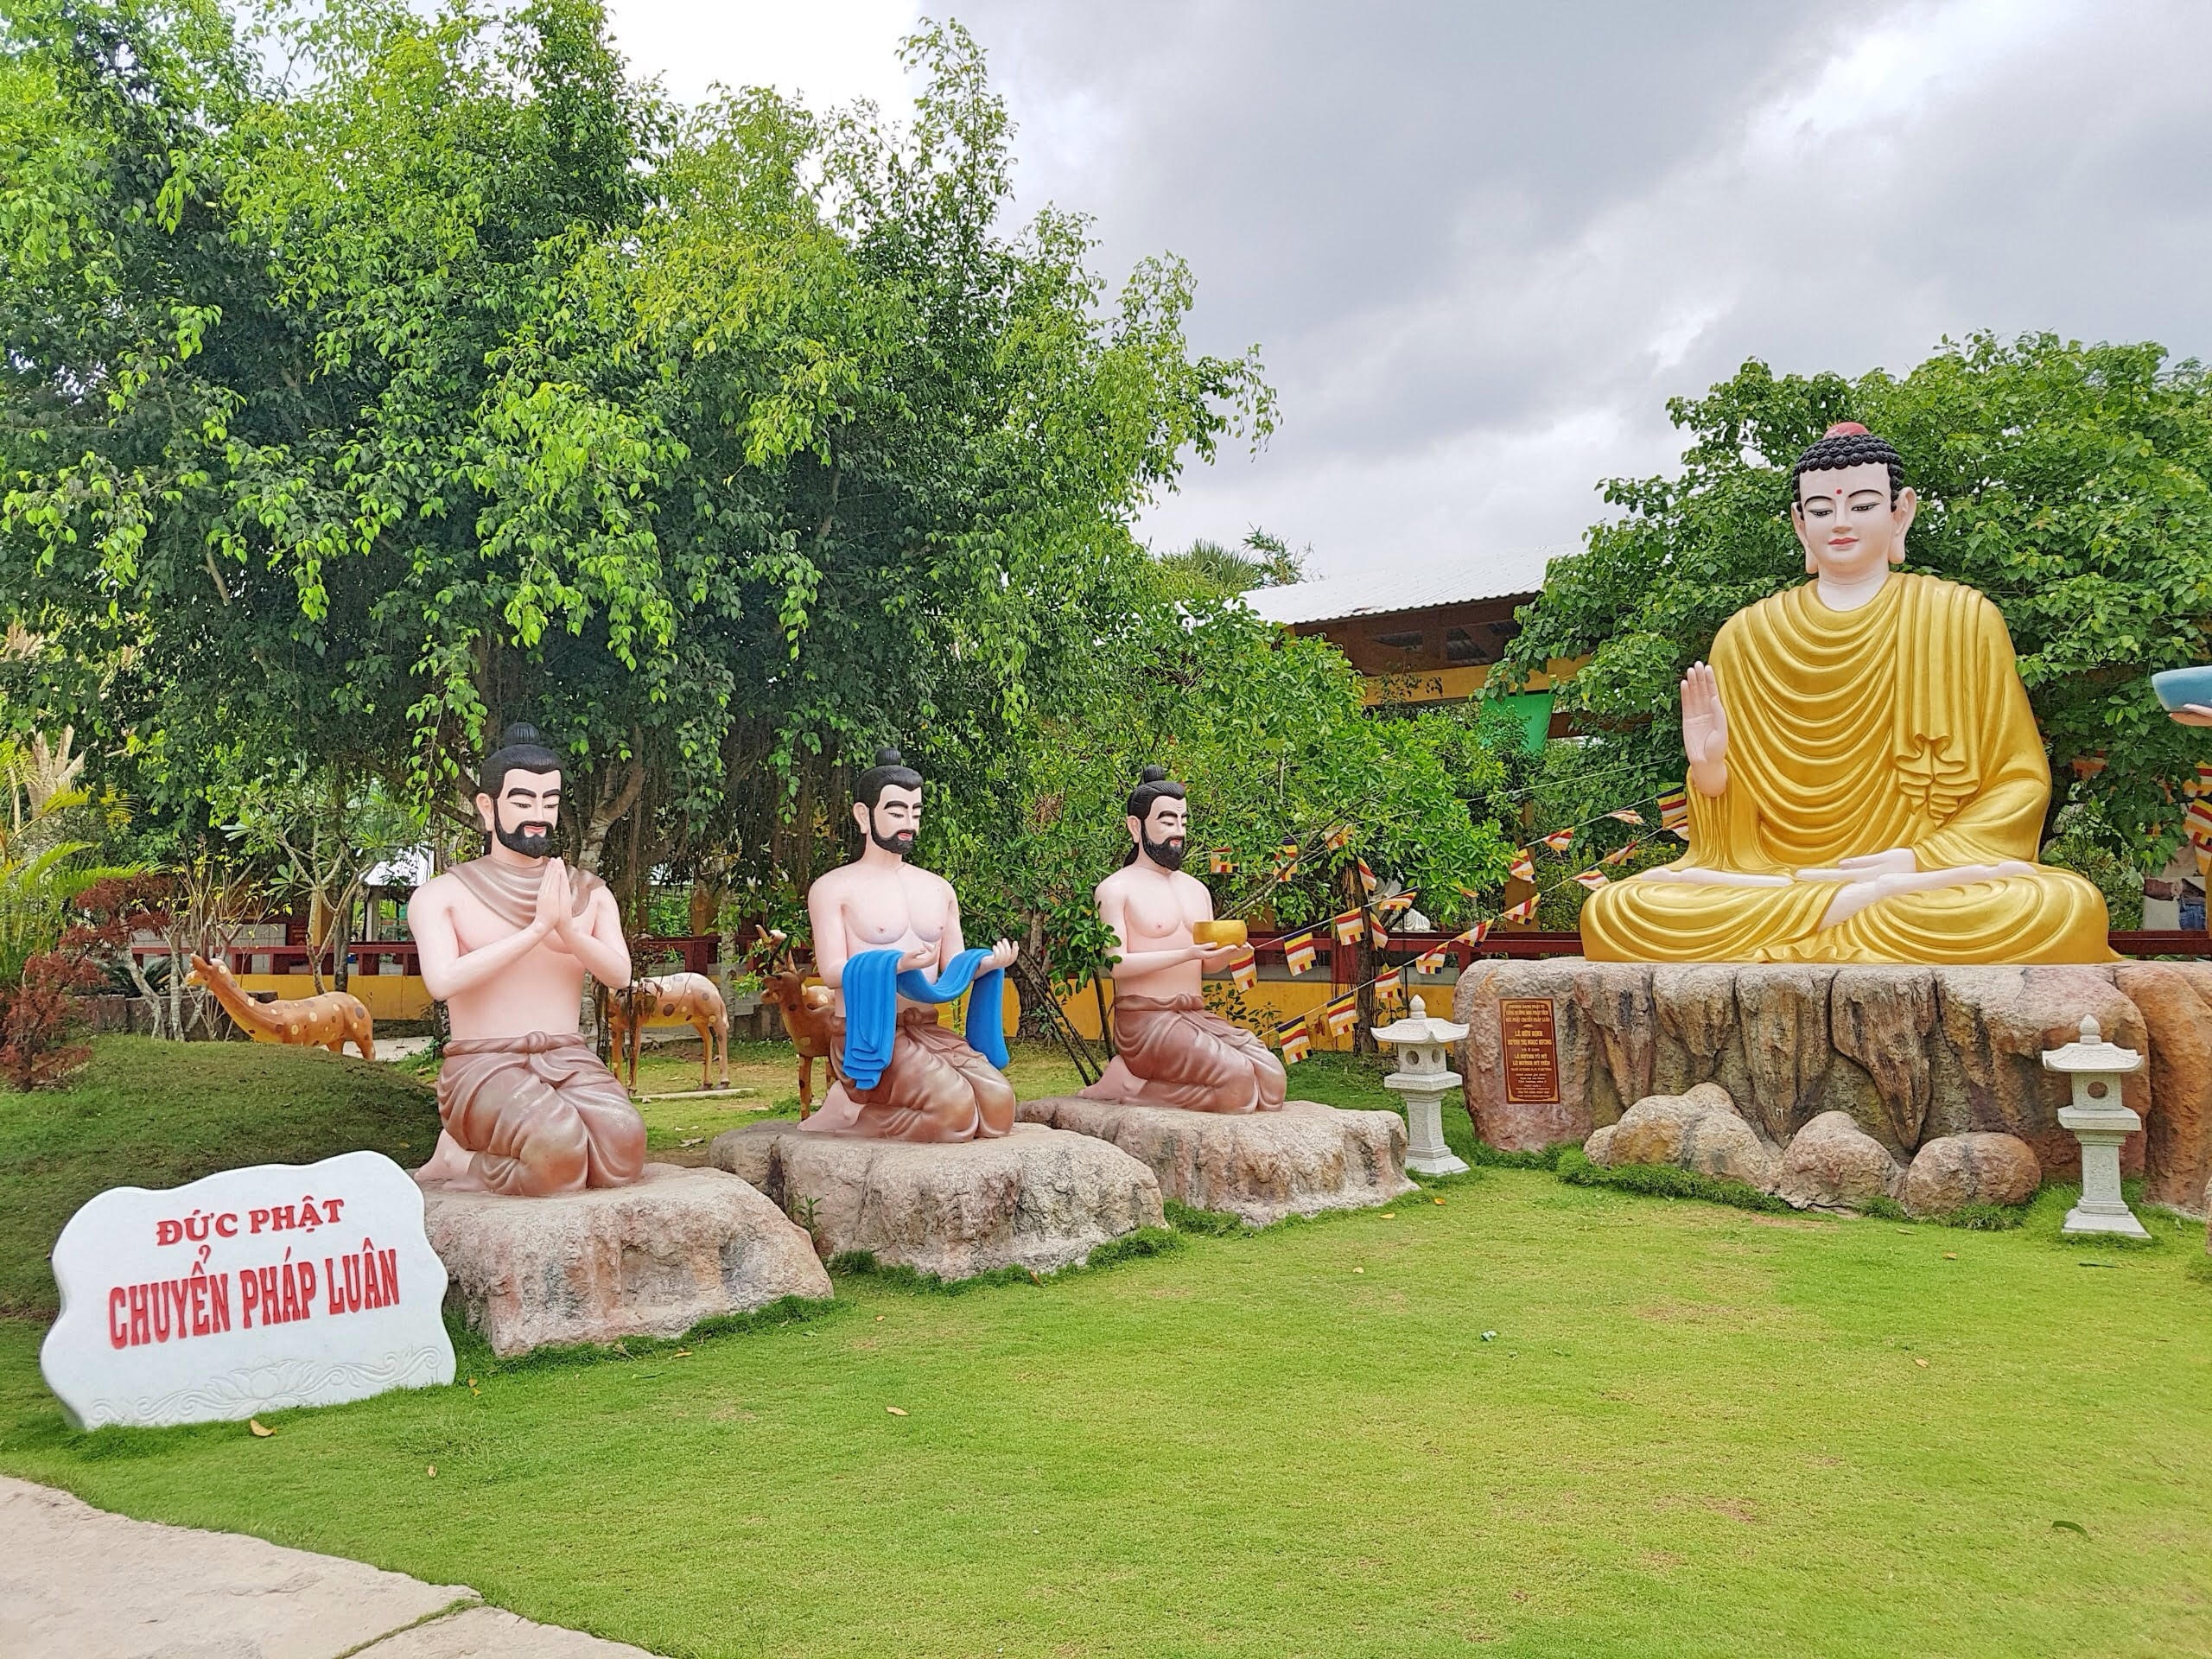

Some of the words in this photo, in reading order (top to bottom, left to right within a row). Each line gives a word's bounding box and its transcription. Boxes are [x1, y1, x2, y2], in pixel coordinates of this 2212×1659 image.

[156, 1209, 238, 1246] ĐỨC
[249, 1196, 344, 1234] PHẬT
[109, 1244, 231, 1350] CHUYỂN
[240, 1246, 316, 1329] PHÁP
[325, 1237, 400, 1315] LUÂN
